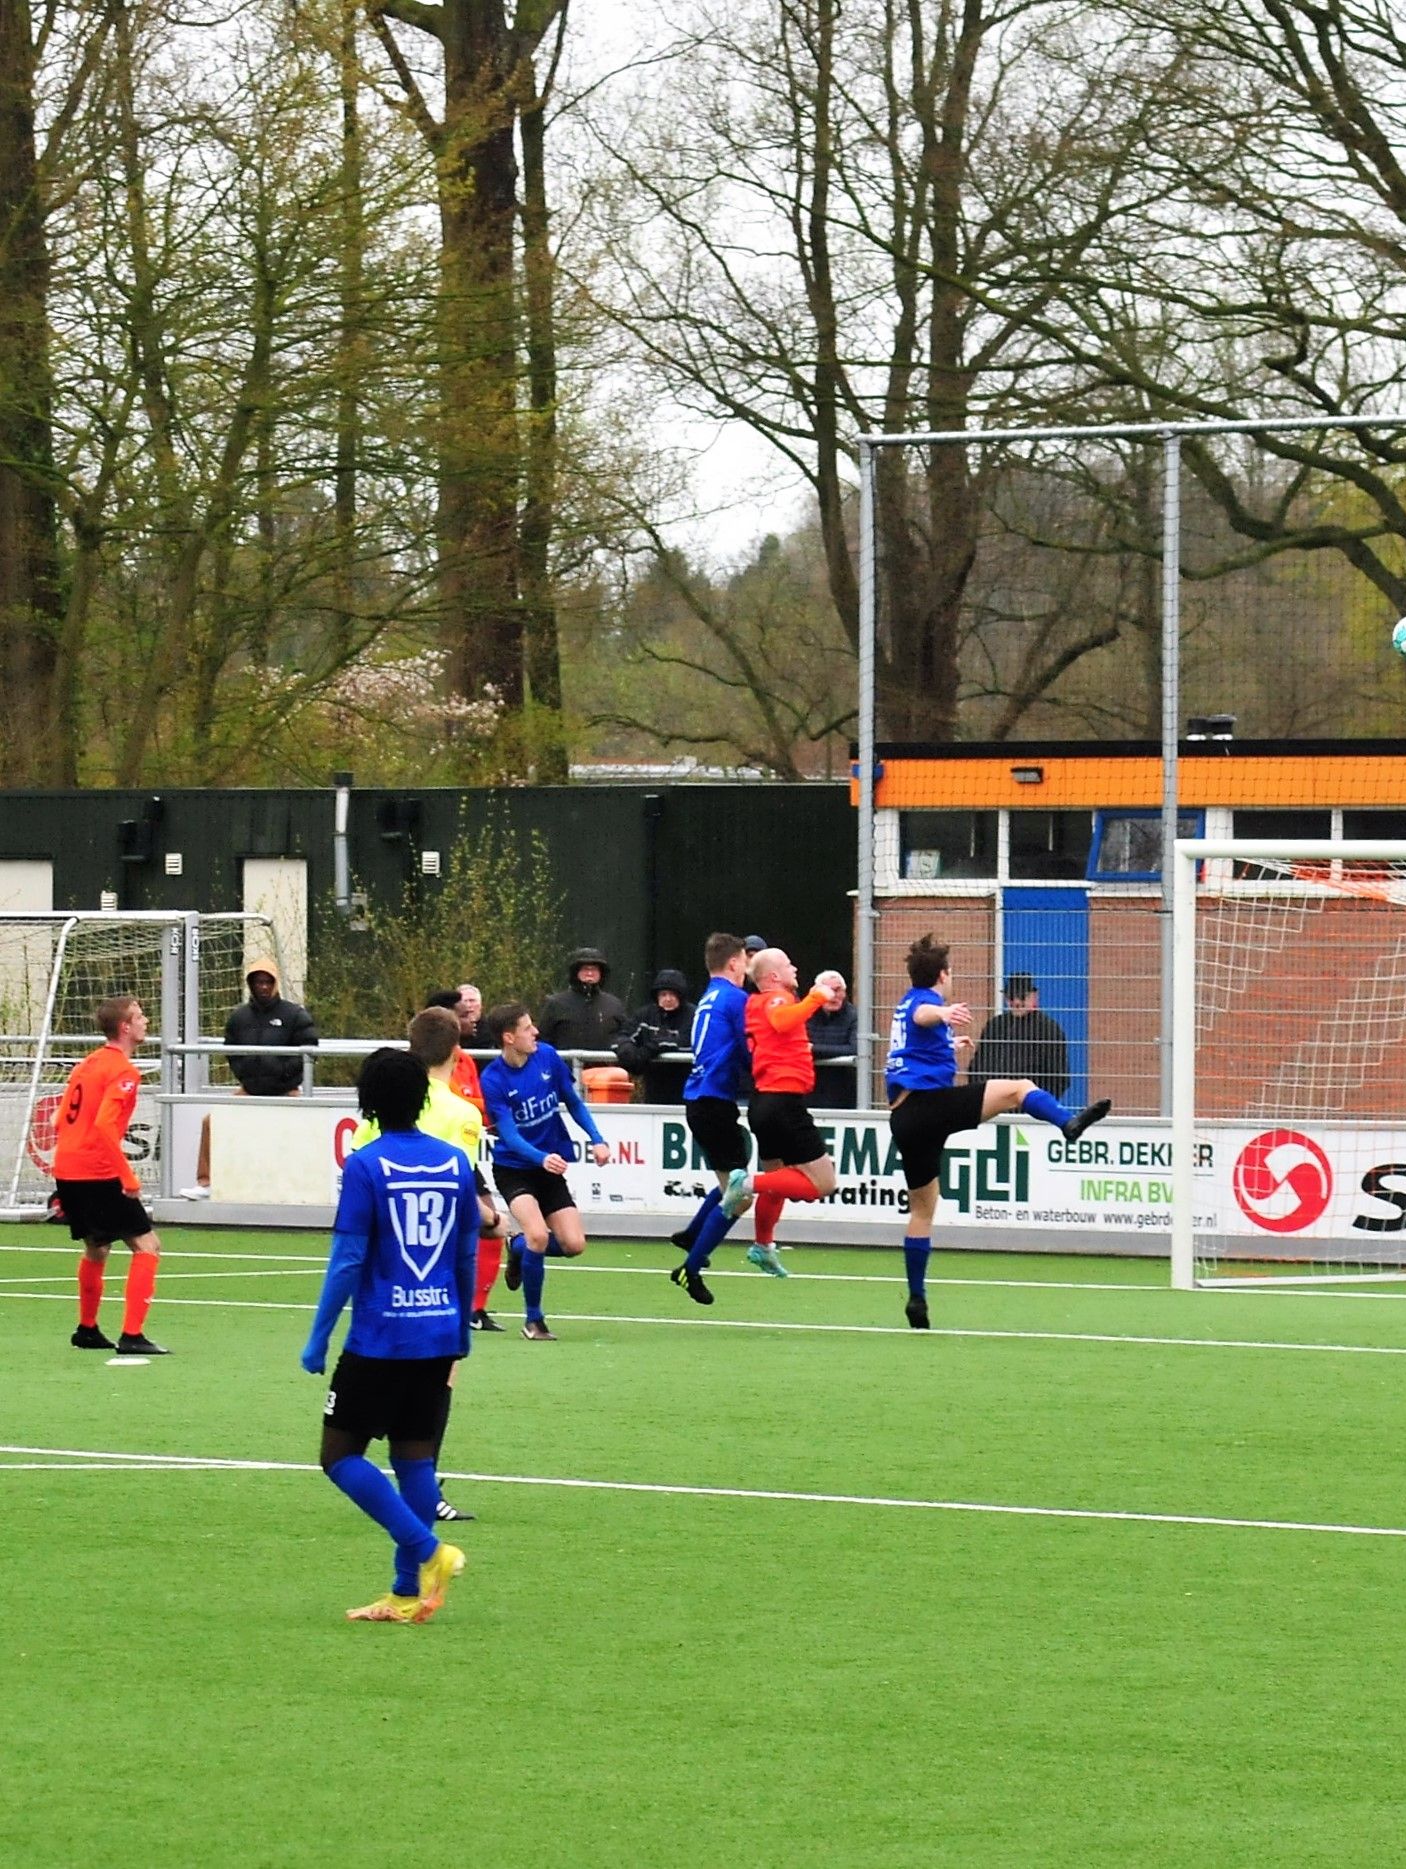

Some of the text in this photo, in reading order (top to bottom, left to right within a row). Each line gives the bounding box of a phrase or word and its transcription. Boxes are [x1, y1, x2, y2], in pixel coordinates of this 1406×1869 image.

[65, 1083, 83, 1125] 9
[514, 1090, 559, 1121] dFrm
[1047, 1139, 1214, 1169] GEBR. DEKR
[1080, 1178, 1174, 1203] INFRA BV
[402, 1190, 445, 1247] 13
[975, 1205, 1012, 1220] Beton-
[1015, 1209, 1029, 1221] en
[1033, 1208, 1096, 1223] waterbouw
